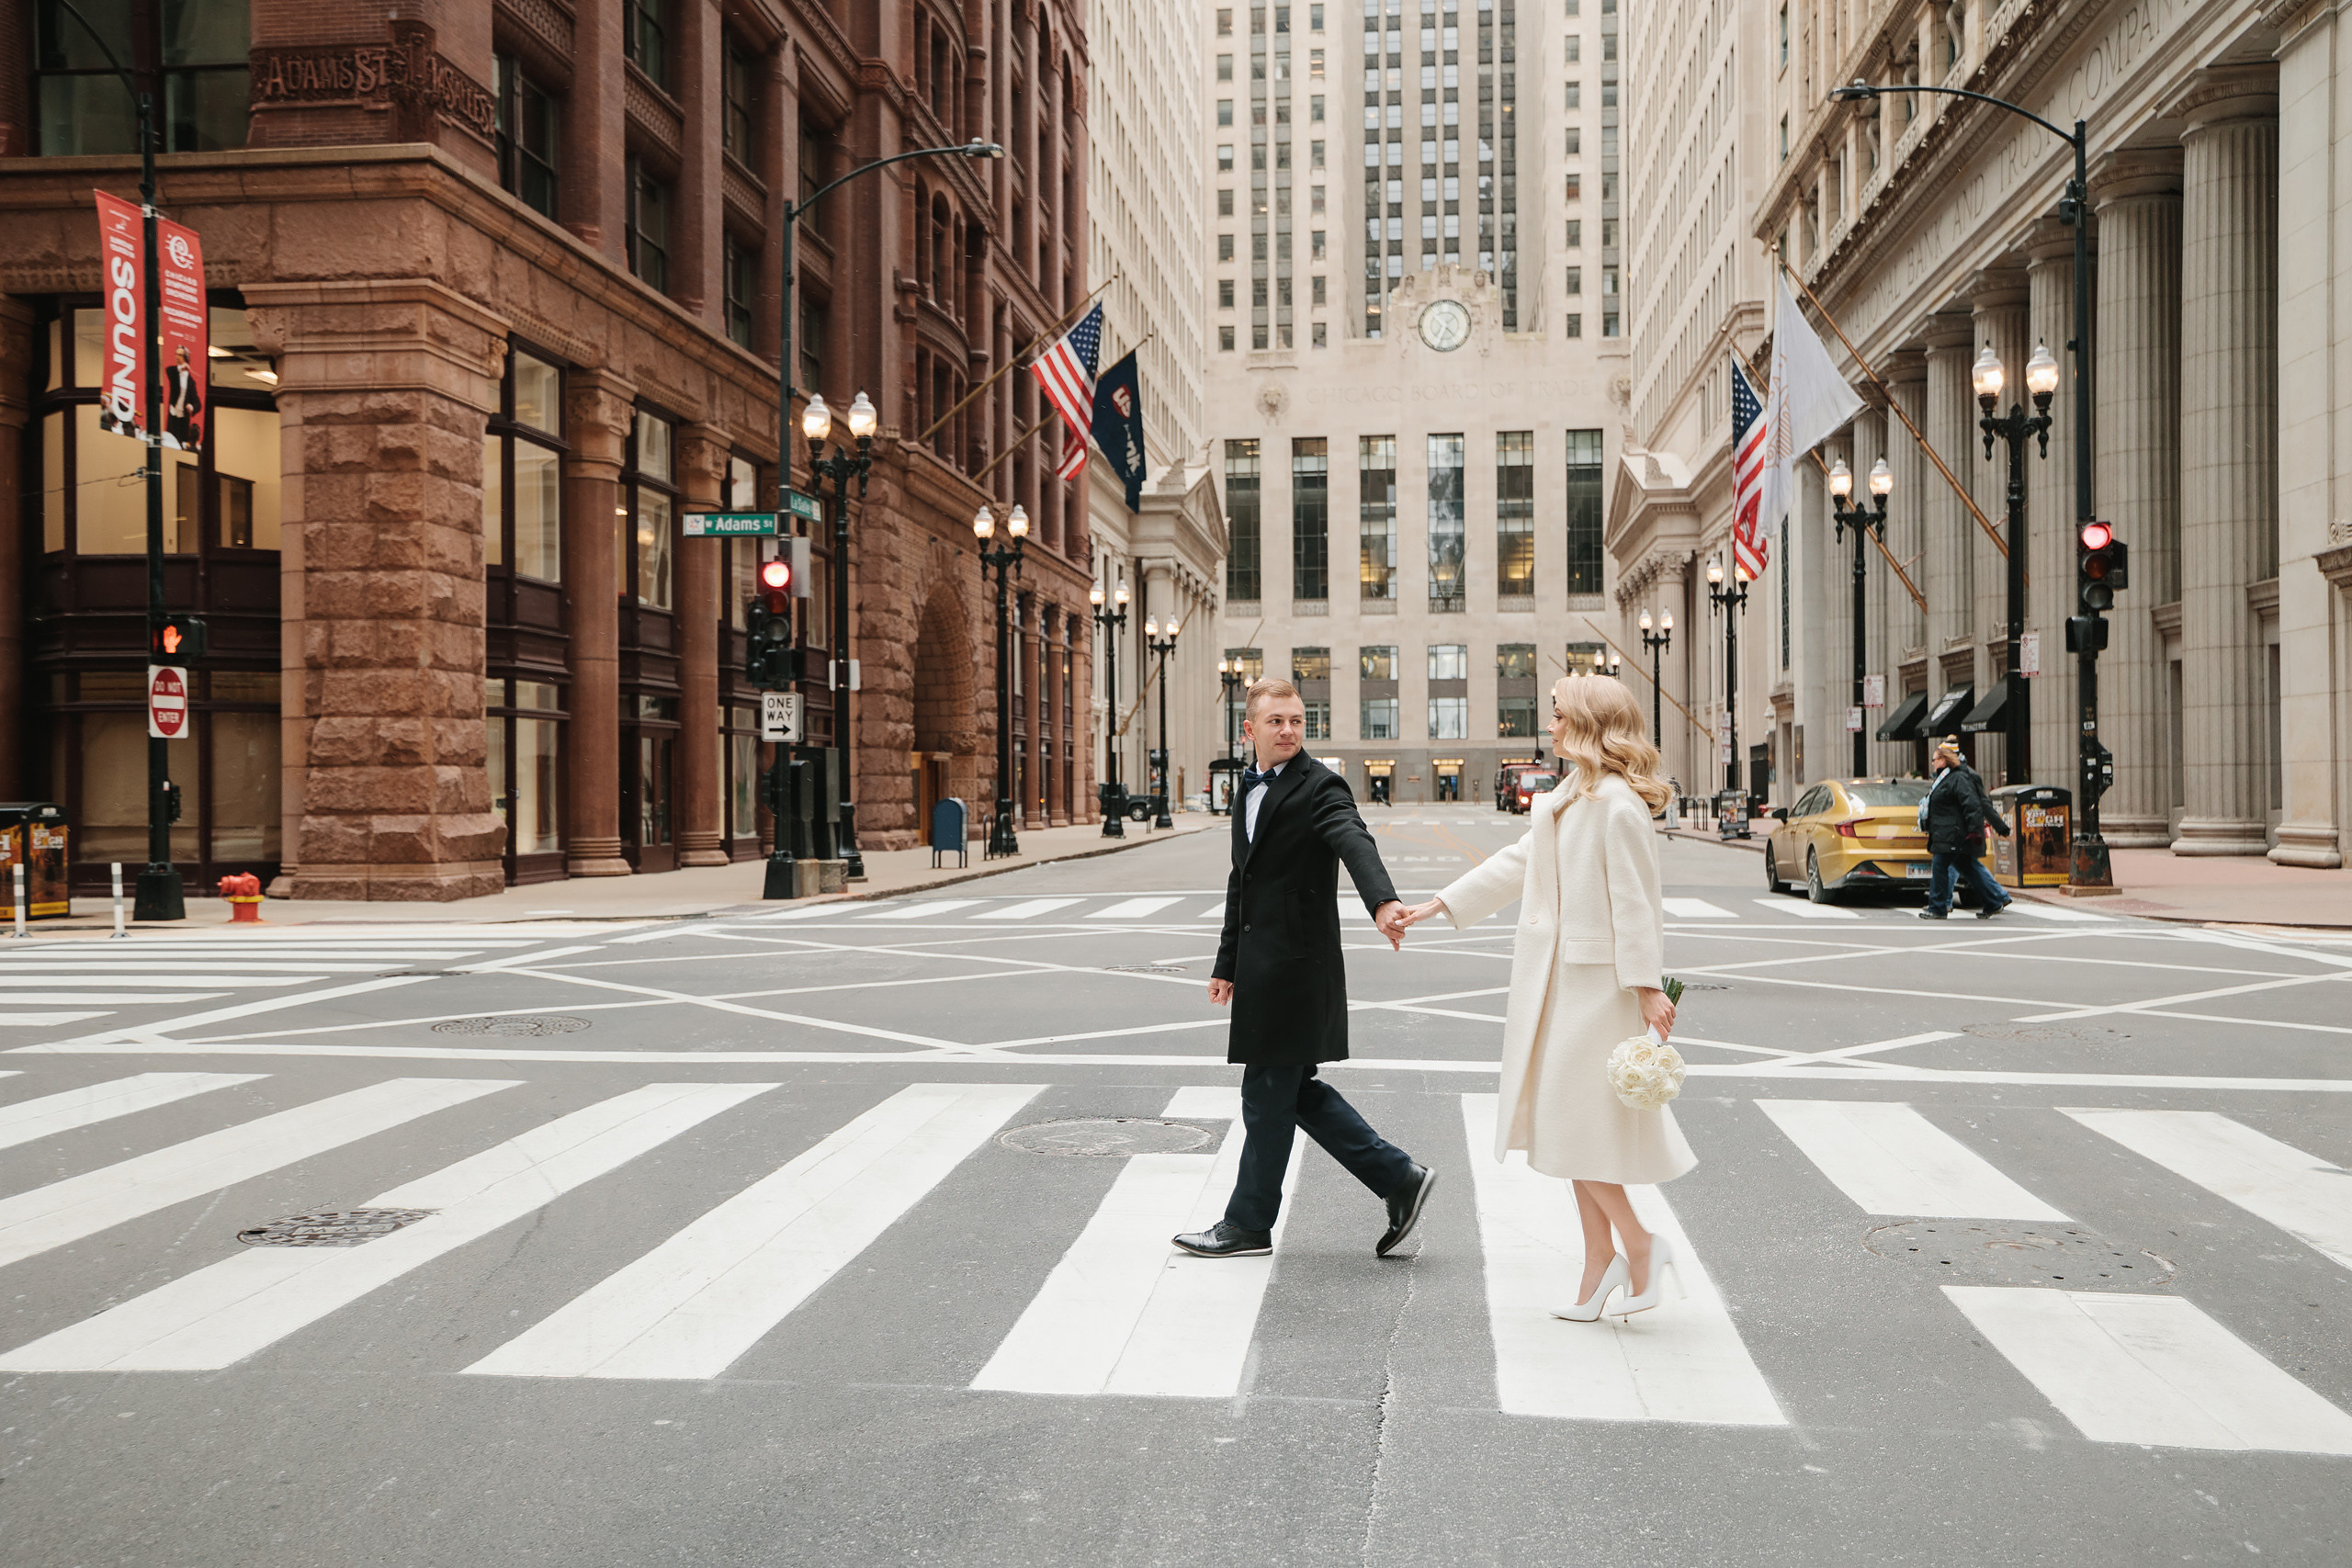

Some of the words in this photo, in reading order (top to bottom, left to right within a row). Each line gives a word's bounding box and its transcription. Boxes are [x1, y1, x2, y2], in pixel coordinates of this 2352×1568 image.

[265, 56, 354, 96] ADAMS
[1906, 217, 1943, 286] BANK
[1952, 174, 1984, 243] AND
[1997, 96, 2055, 192] TRUST
[2068, 0, 2190, 119] COMPAN
[110, 256, 136, 422] SOUND
[1306, 386, 1403, 404] CHICAGO
[1411, 382, 1479, 401] BOARD
[1488, 382, 1514, 399] OF
[1527, 378, 1592, 398] TRADE
[705, 520, 713, 528] W
[715, 517, 761, 531] Adams
[763, 520, 774, 528] St
[154, 681, 165, 692] DO
[167, 682, 181, 693] NOT
[767, 697, 793, 708] ONE
[158, 711, 180, 724] ENTER
[766, 711, 793, 721] WAY
